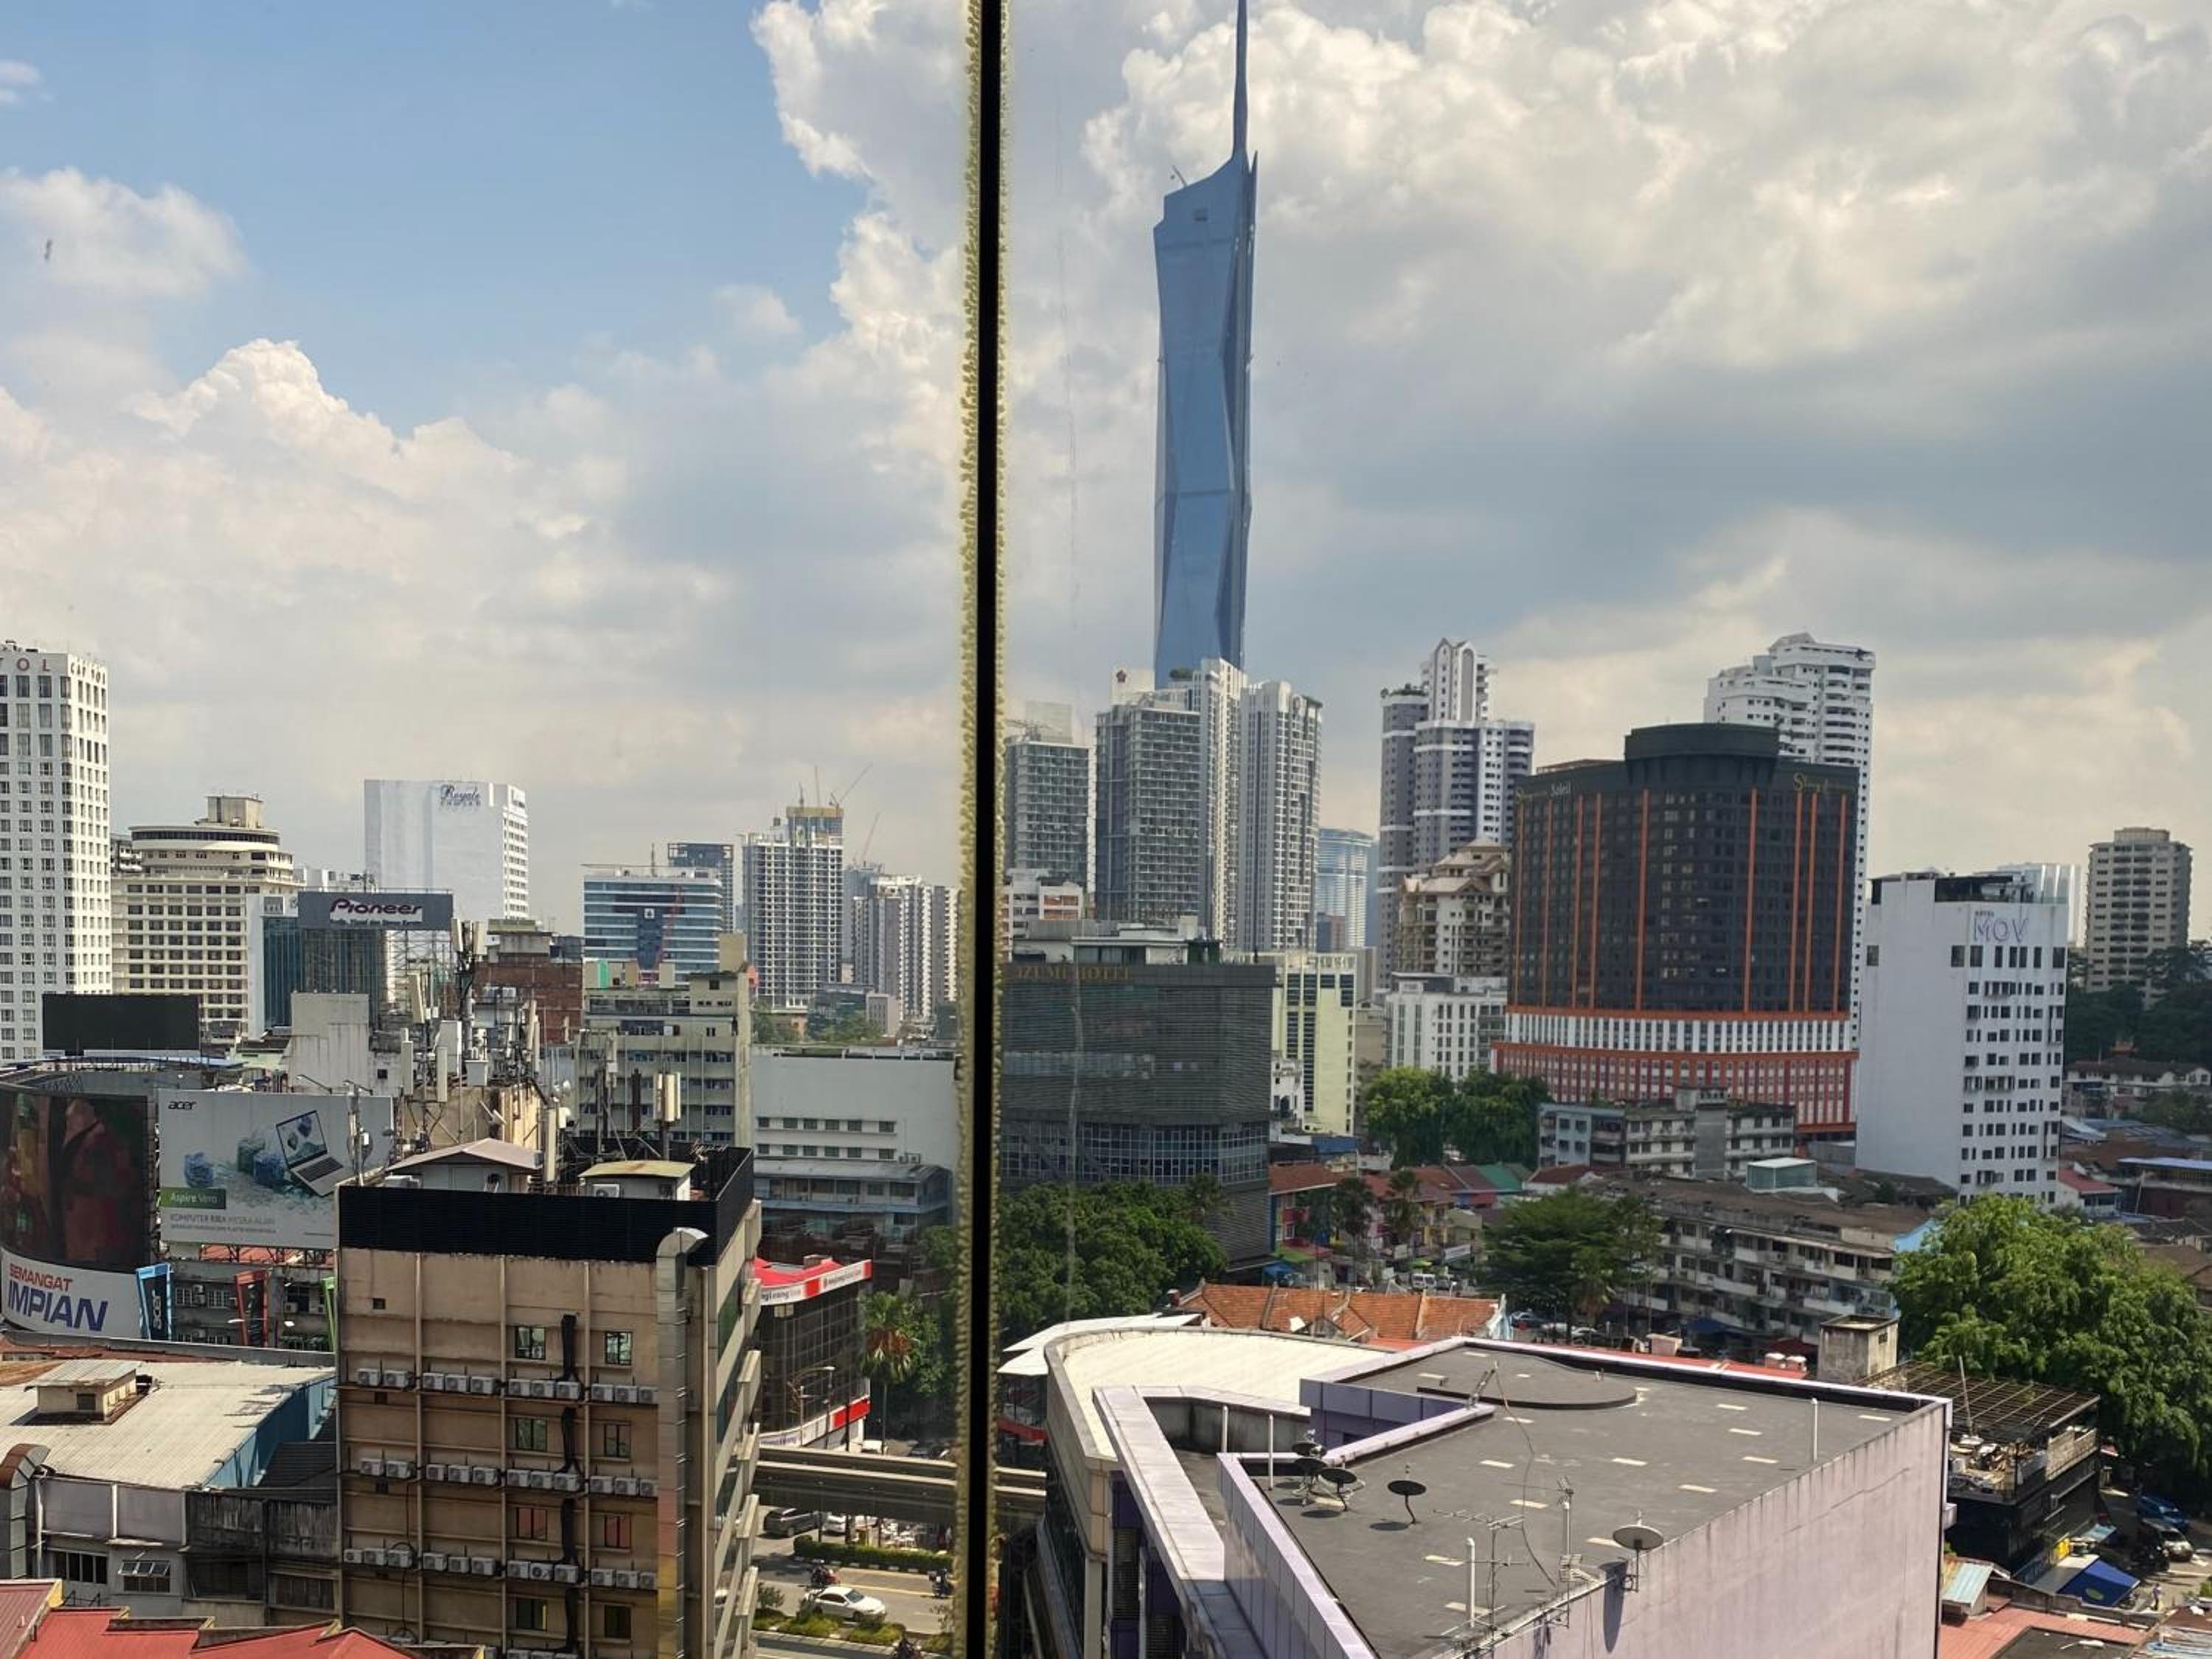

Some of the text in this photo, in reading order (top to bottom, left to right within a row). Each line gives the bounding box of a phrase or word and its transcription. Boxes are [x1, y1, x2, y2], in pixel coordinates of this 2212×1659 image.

[330, 898, 422, 914] Pioneer
[1973, 917, 2028, 942] MOV
[167, 1101, 197, 1110] acer
[170, 1192, 198, 1204] Aspire
[9, 1262, 73, 1293] SEMANGAT
[7, 1279, 108, 1333] IMPIAN
